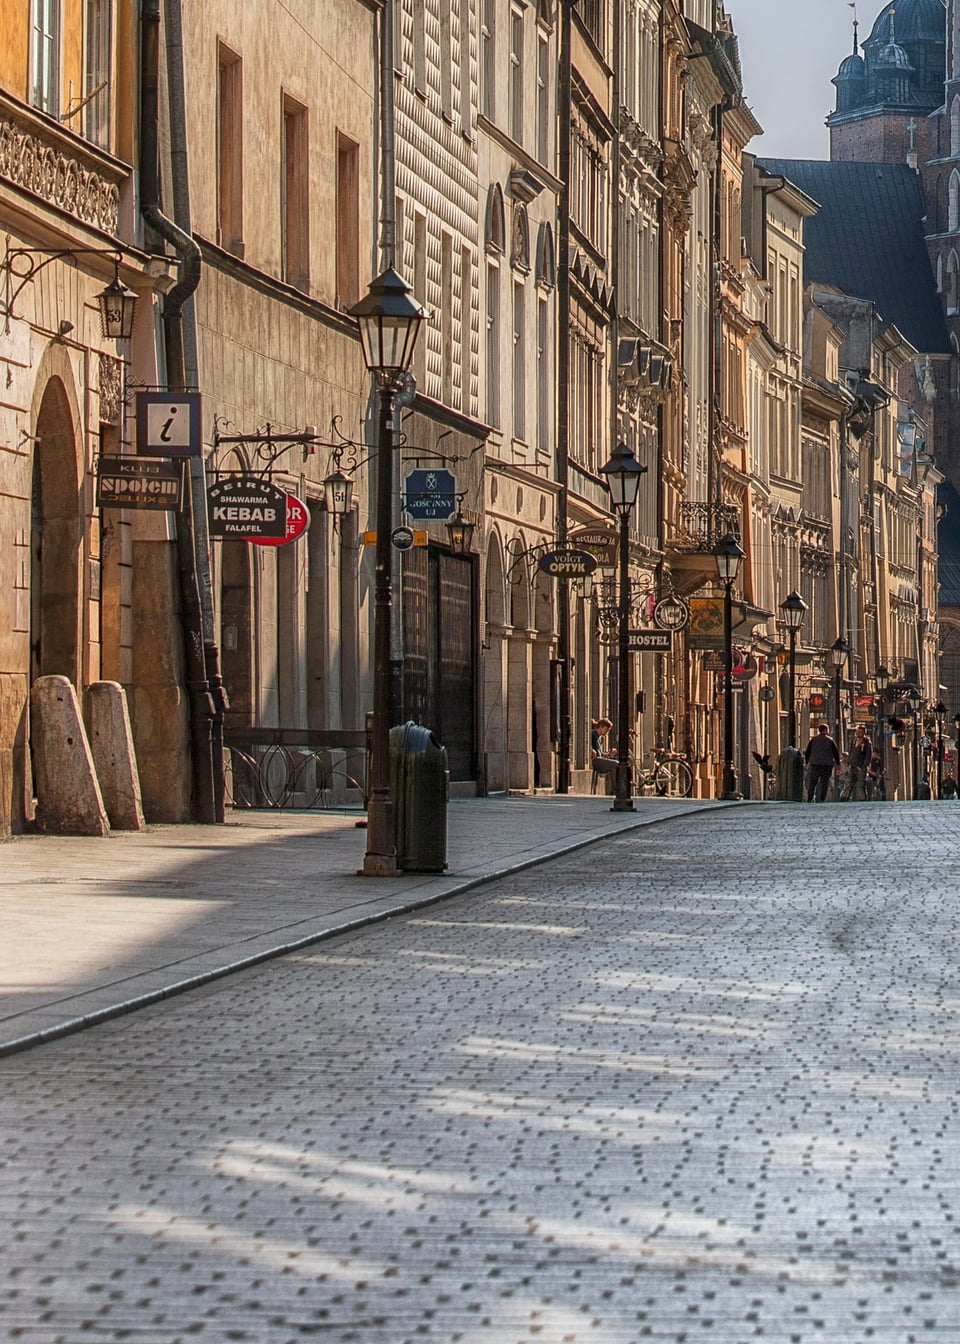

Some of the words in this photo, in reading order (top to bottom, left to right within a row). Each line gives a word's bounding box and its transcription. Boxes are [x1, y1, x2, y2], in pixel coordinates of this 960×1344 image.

[107, 309, 121, 323] 53
[210, 481, 284, 498] BEIRUT
[220, 495, 268, 504] SHAWARMA
[213, 506, 276, 522] KEBAB
[225, 524, 262, 532] FALAFEL
[549, 562, 585, 573] OPTYK
[629, 635, 669, 646] HOSTEL
